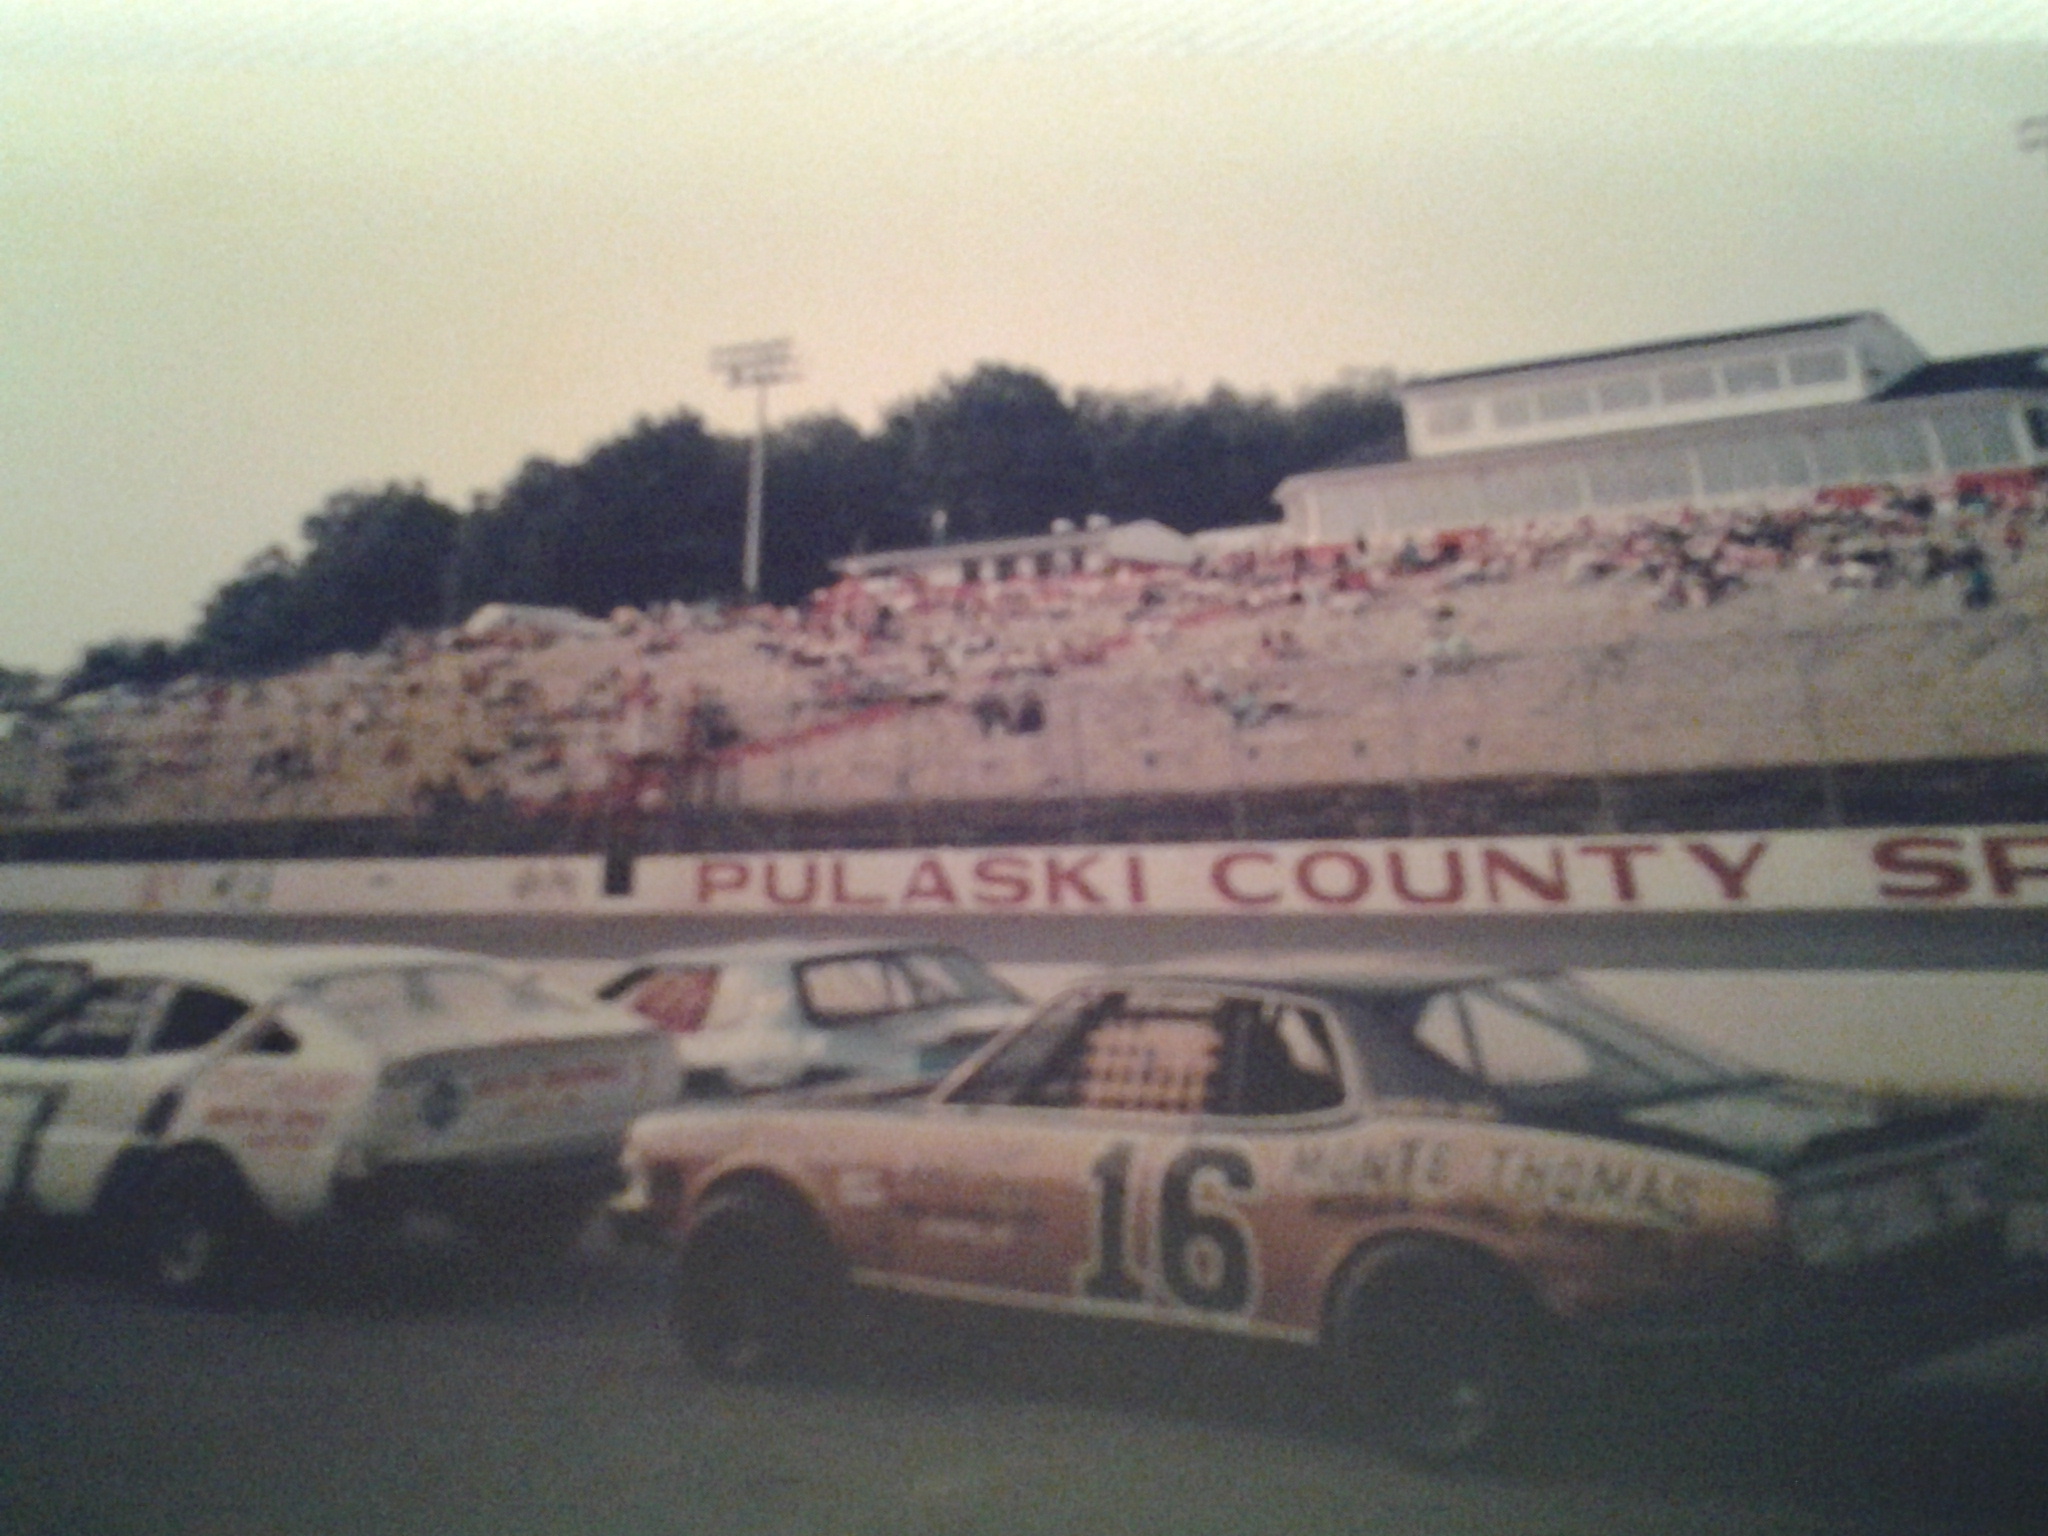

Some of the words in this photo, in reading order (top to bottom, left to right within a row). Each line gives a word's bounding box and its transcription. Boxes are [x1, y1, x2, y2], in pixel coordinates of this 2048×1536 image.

[698, 853, 1147, 907] PULASKI
[1210, 841, 1767, 906] COUNTY
[1074, 1138, 1260, 1314] 16
